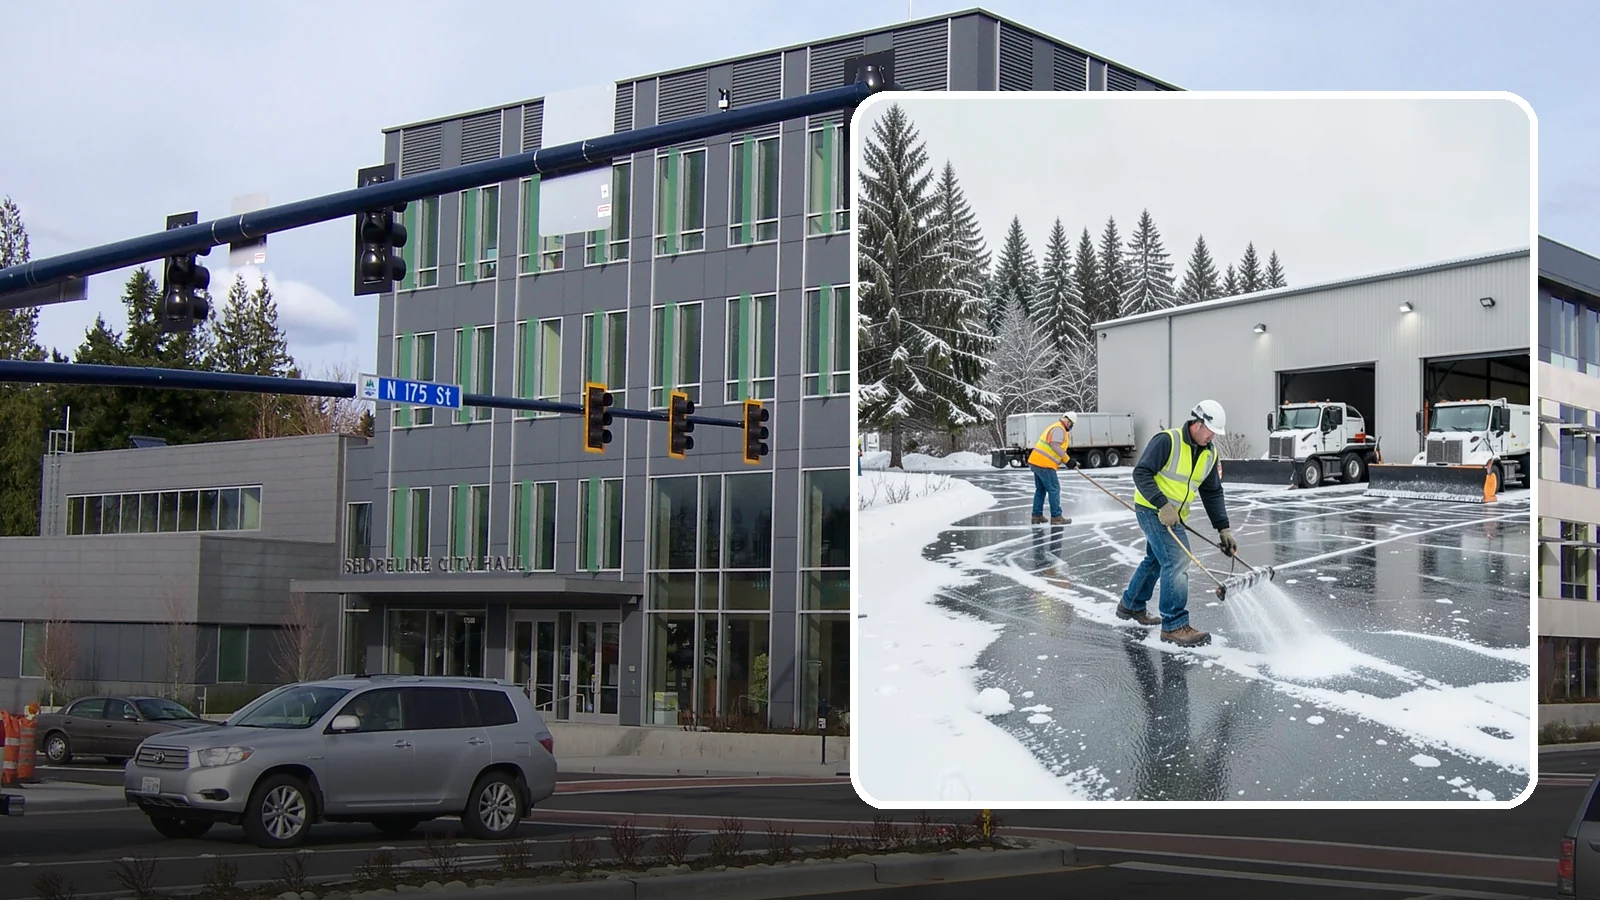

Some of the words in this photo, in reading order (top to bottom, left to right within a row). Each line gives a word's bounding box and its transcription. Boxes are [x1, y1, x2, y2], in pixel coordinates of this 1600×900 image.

[387, 380, 396, 399] N
[405, 382, 427, 403] 175
[436, 386, 451, 406] St
[343, 556, 432, 574] SHORELINE
[438, 556, 476, 573] CITY
[483, 555, 526, 571] HALL
